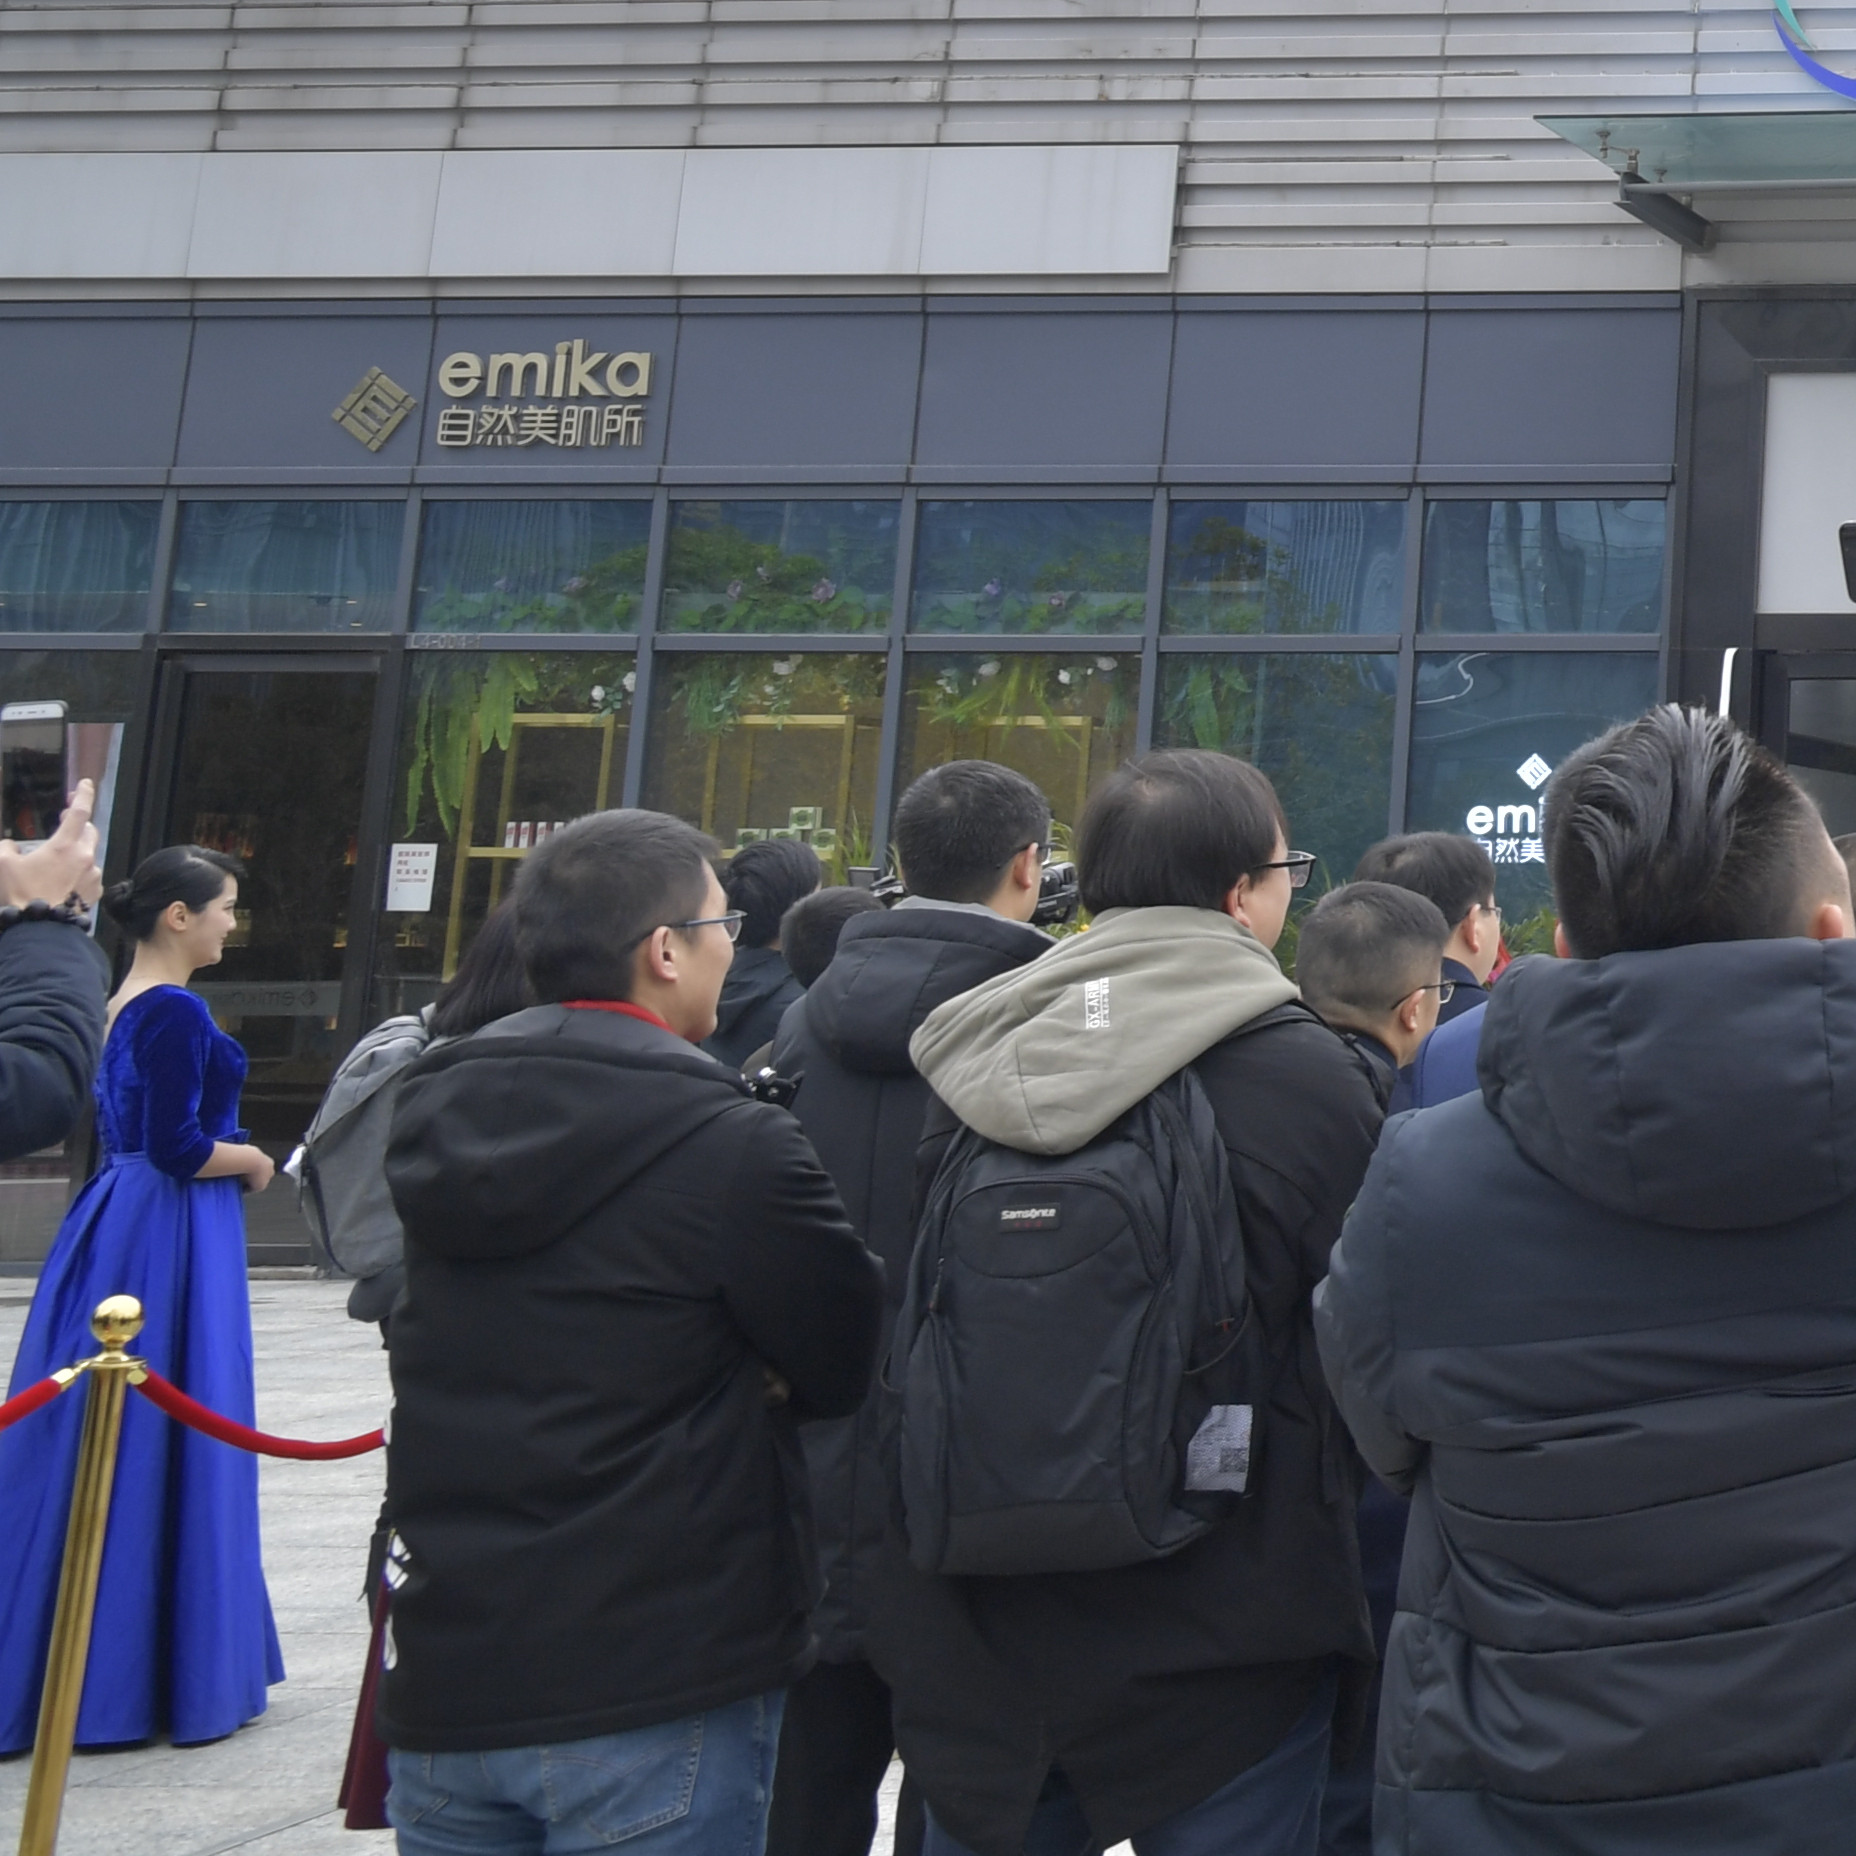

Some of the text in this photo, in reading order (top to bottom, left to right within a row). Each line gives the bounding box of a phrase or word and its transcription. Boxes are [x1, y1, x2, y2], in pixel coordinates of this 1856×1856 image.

[438, 338, 654, 397] emika
[436, 404, 646, 447] 自然美肌所
